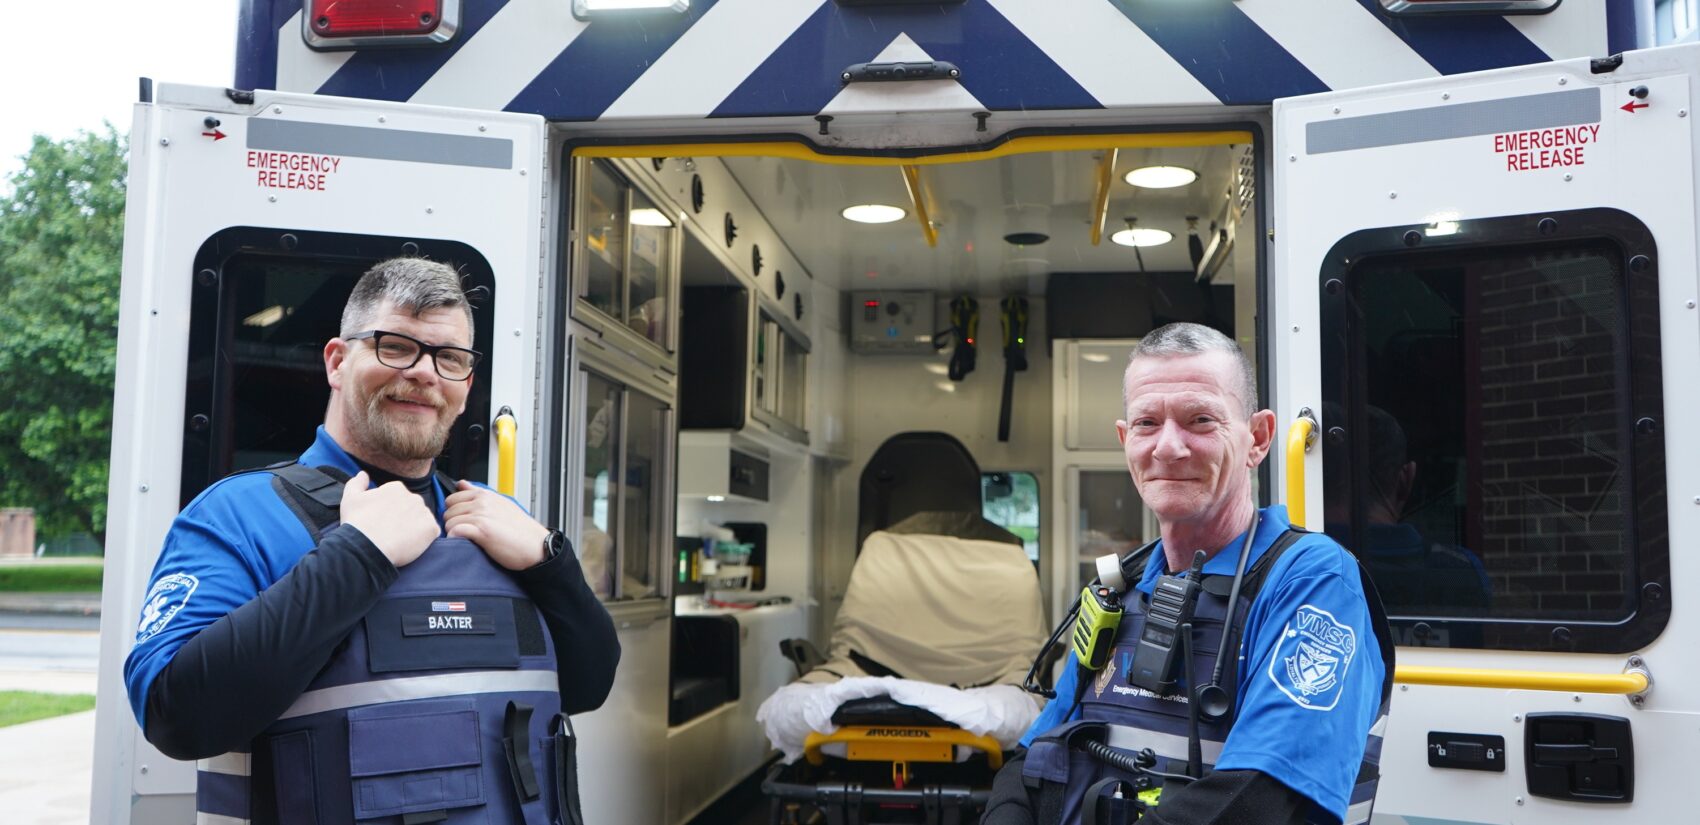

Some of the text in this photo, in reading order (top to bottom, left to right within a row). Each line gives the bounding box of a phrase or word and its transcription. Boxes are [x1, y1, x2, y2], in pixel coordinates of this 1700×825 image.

[1494, 124, 1600, 153] EMERGENCY
[247, 151, 340, 173] EMERGENCY
[1507, 147, 1585, 172] RELEASE
[257, 171, 326, 191] RELEASE
[428, 616, 473, 629] BAXTER
[1296, 610, 1353, 654] VMSC
[1112, 684, 1140, 697] Emergency
